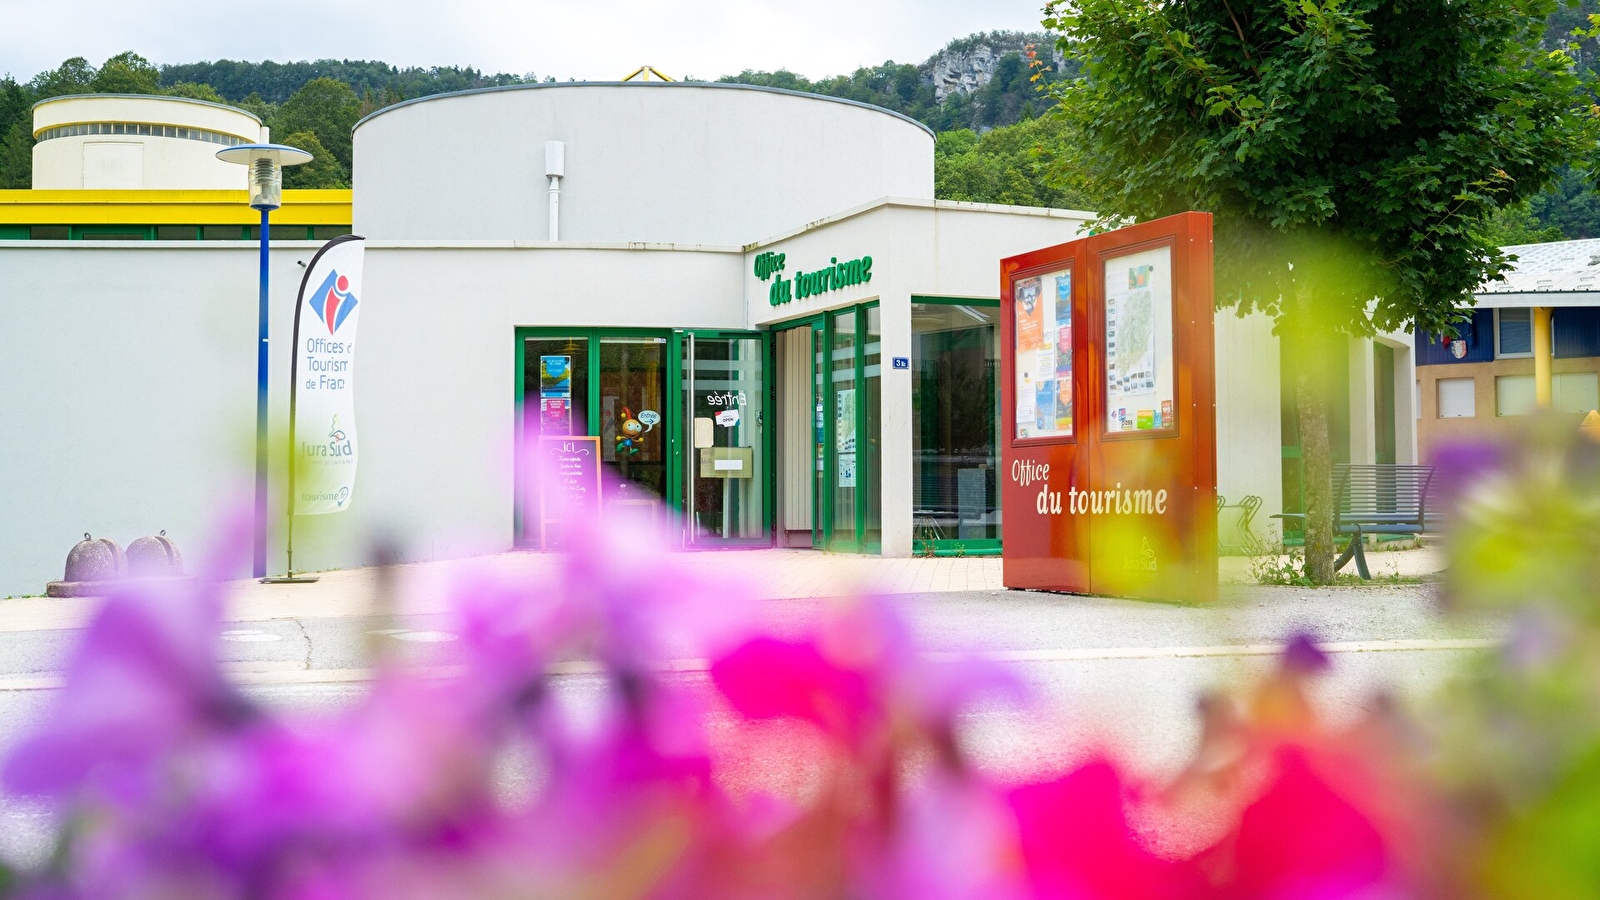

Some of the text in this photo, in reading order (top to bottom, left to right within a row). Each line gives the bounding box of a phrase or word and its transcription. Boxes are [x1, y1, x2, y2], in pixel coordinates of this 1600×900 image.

[754, 251, 786, 281] Office
[770, 255, 873, 306] du tourisme
[307, 338, 344, 354] Offices
[896, 359, 901, 367] 3
[306, 378, 316, 390] de
[301, 440, 353, 459] Jura Sud
[1011, 459, 1050, 487] Office
[1036, 481, 1168, 515] du tourisme
[1140, 556, 1157, 571] Sud
